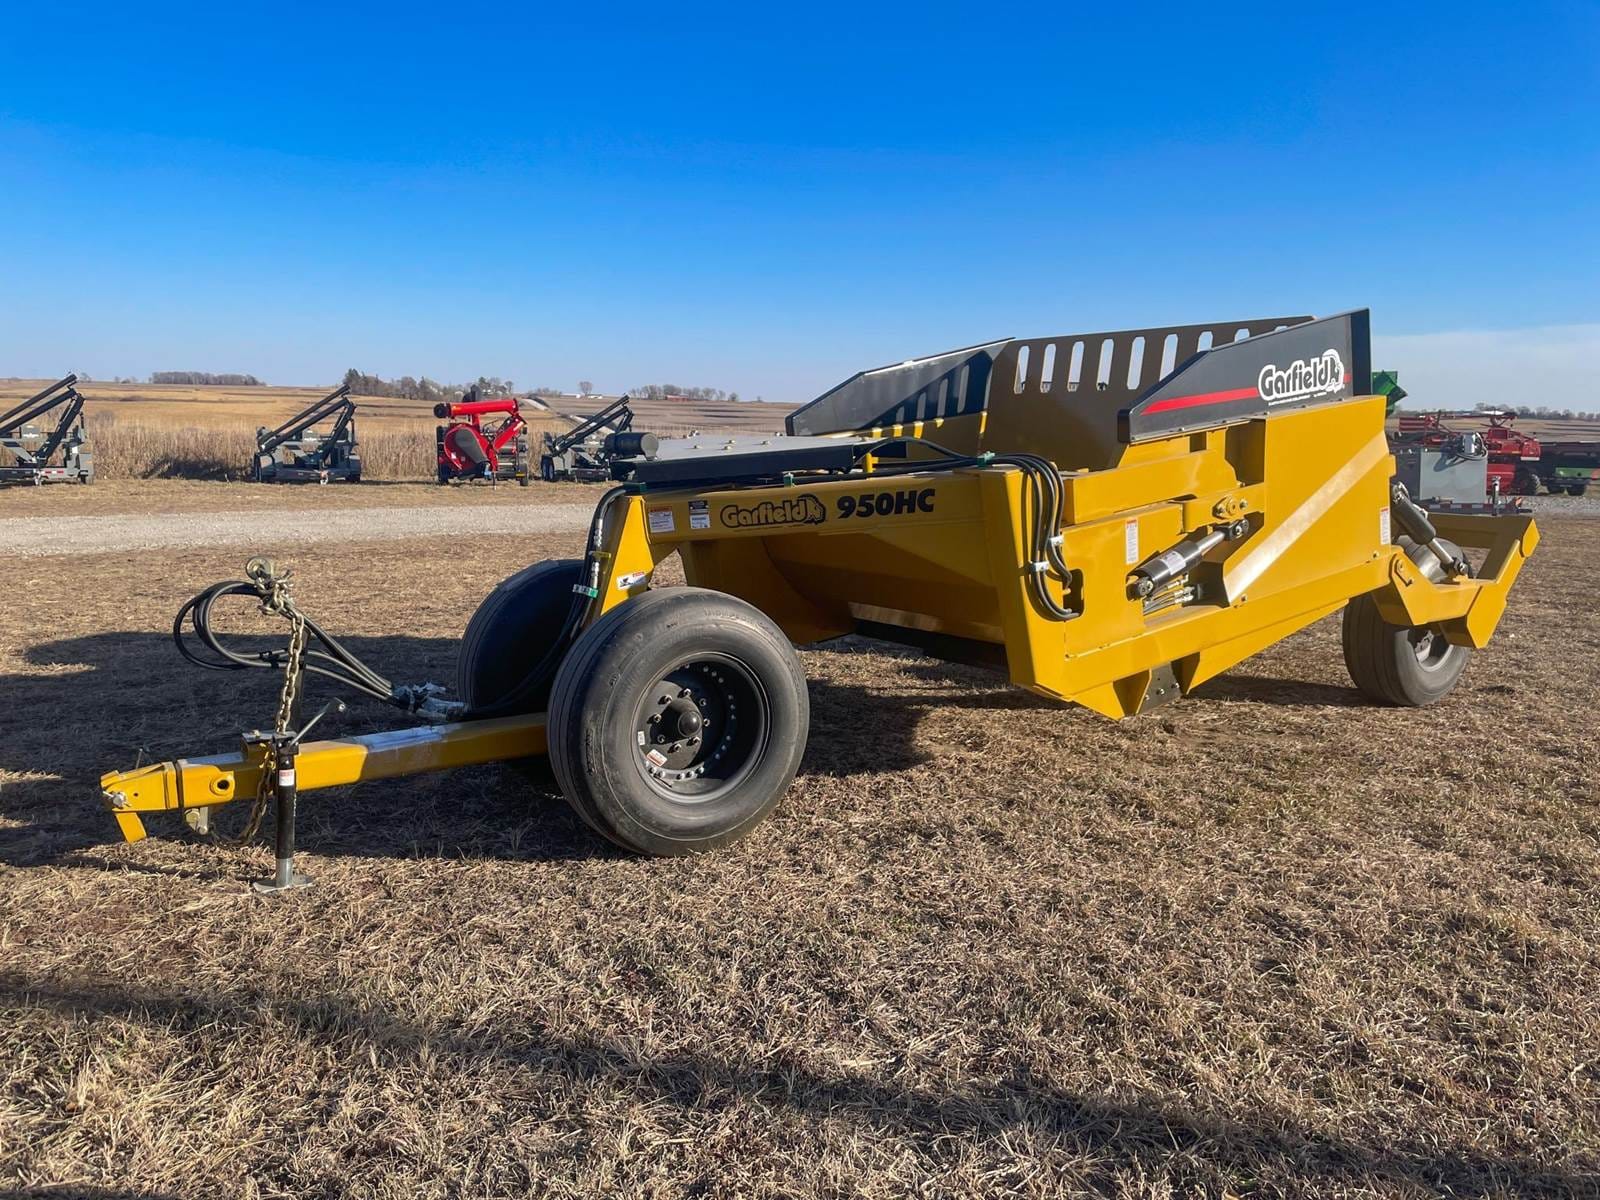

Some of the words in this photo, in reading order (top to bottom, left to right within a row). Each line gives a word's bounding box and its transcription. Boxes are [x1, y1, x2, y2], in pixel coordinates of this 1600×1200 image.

[1258, 355, 1331, 401] Garfield
[720, 499, 809, 528] Garfield
[837, 488, 936, 519] 950HC
